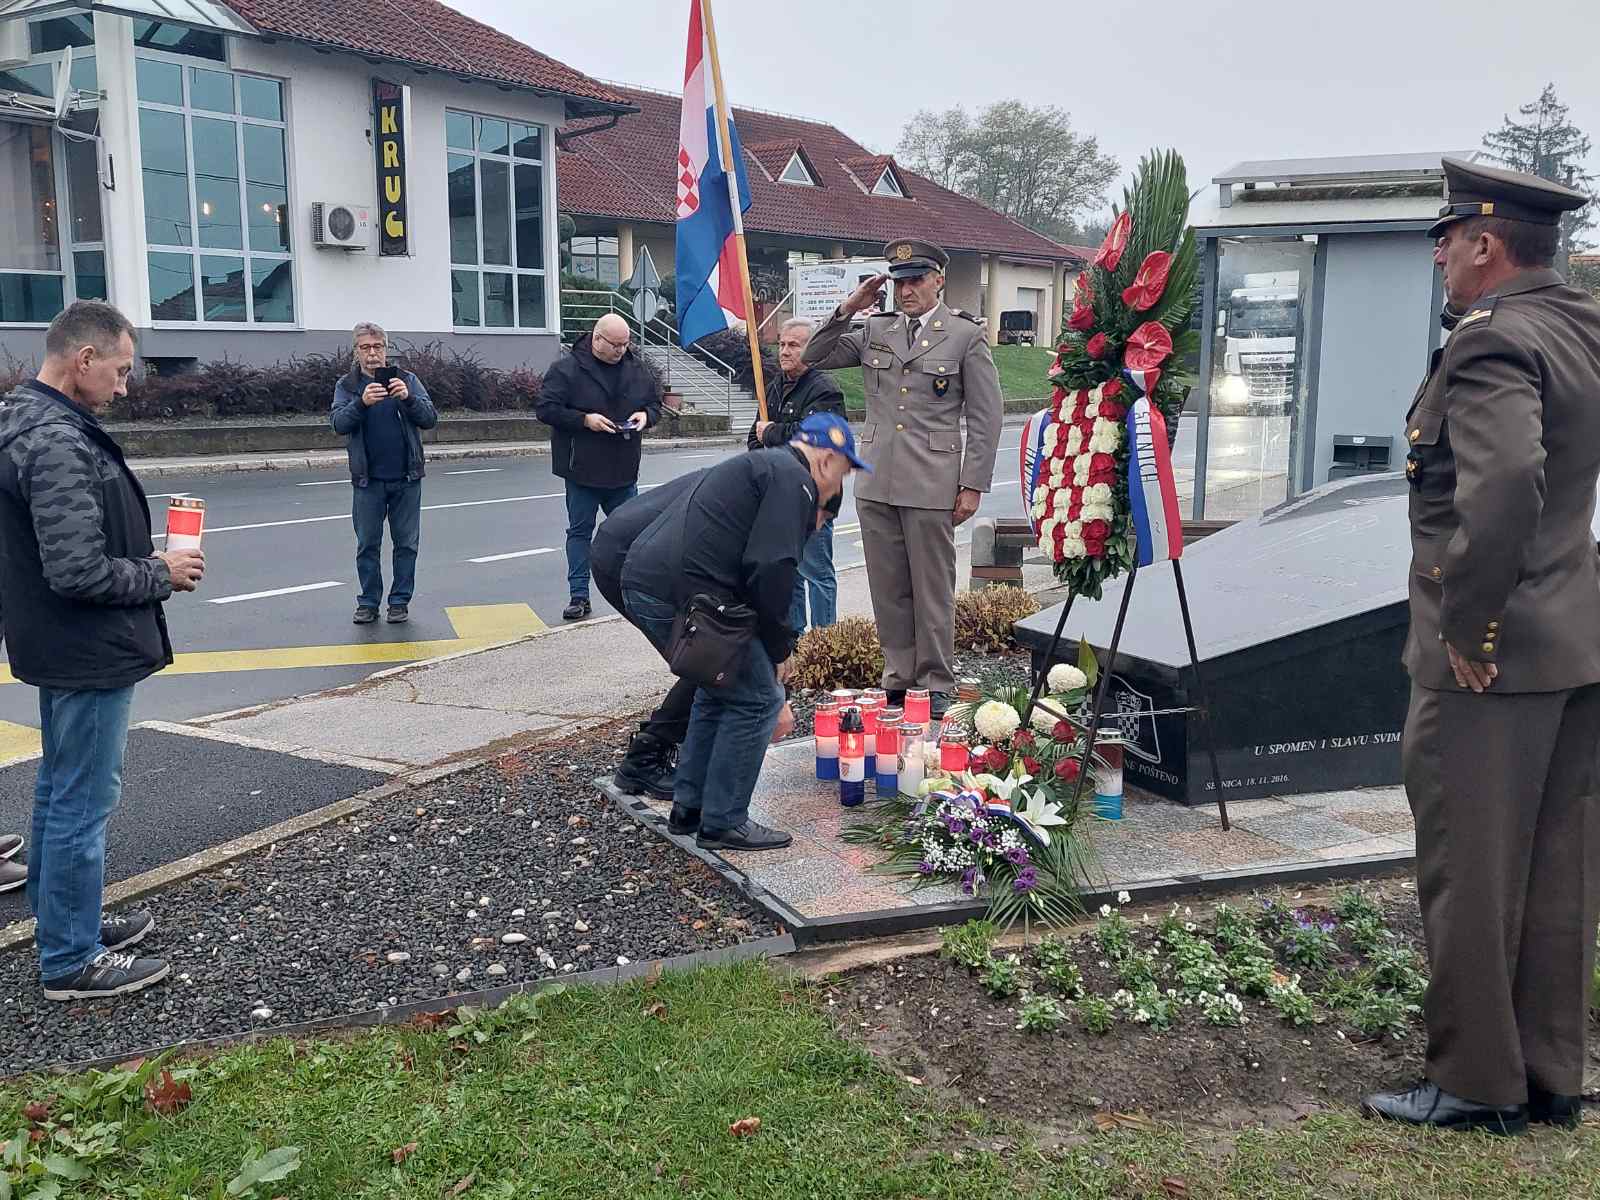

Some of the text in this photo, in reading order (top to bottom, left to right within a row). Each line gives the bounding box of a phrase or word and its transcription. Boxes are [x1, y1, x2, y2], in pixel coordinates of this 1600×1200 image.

[381, 105, 404, 238] KRUG
[1254, 732, 1401, 756] U SPOMEN I SLAVU SVIM
[1138, 764, 1179, 785] POŠTENO
[1205, 779, 1242, 791] SENICA
